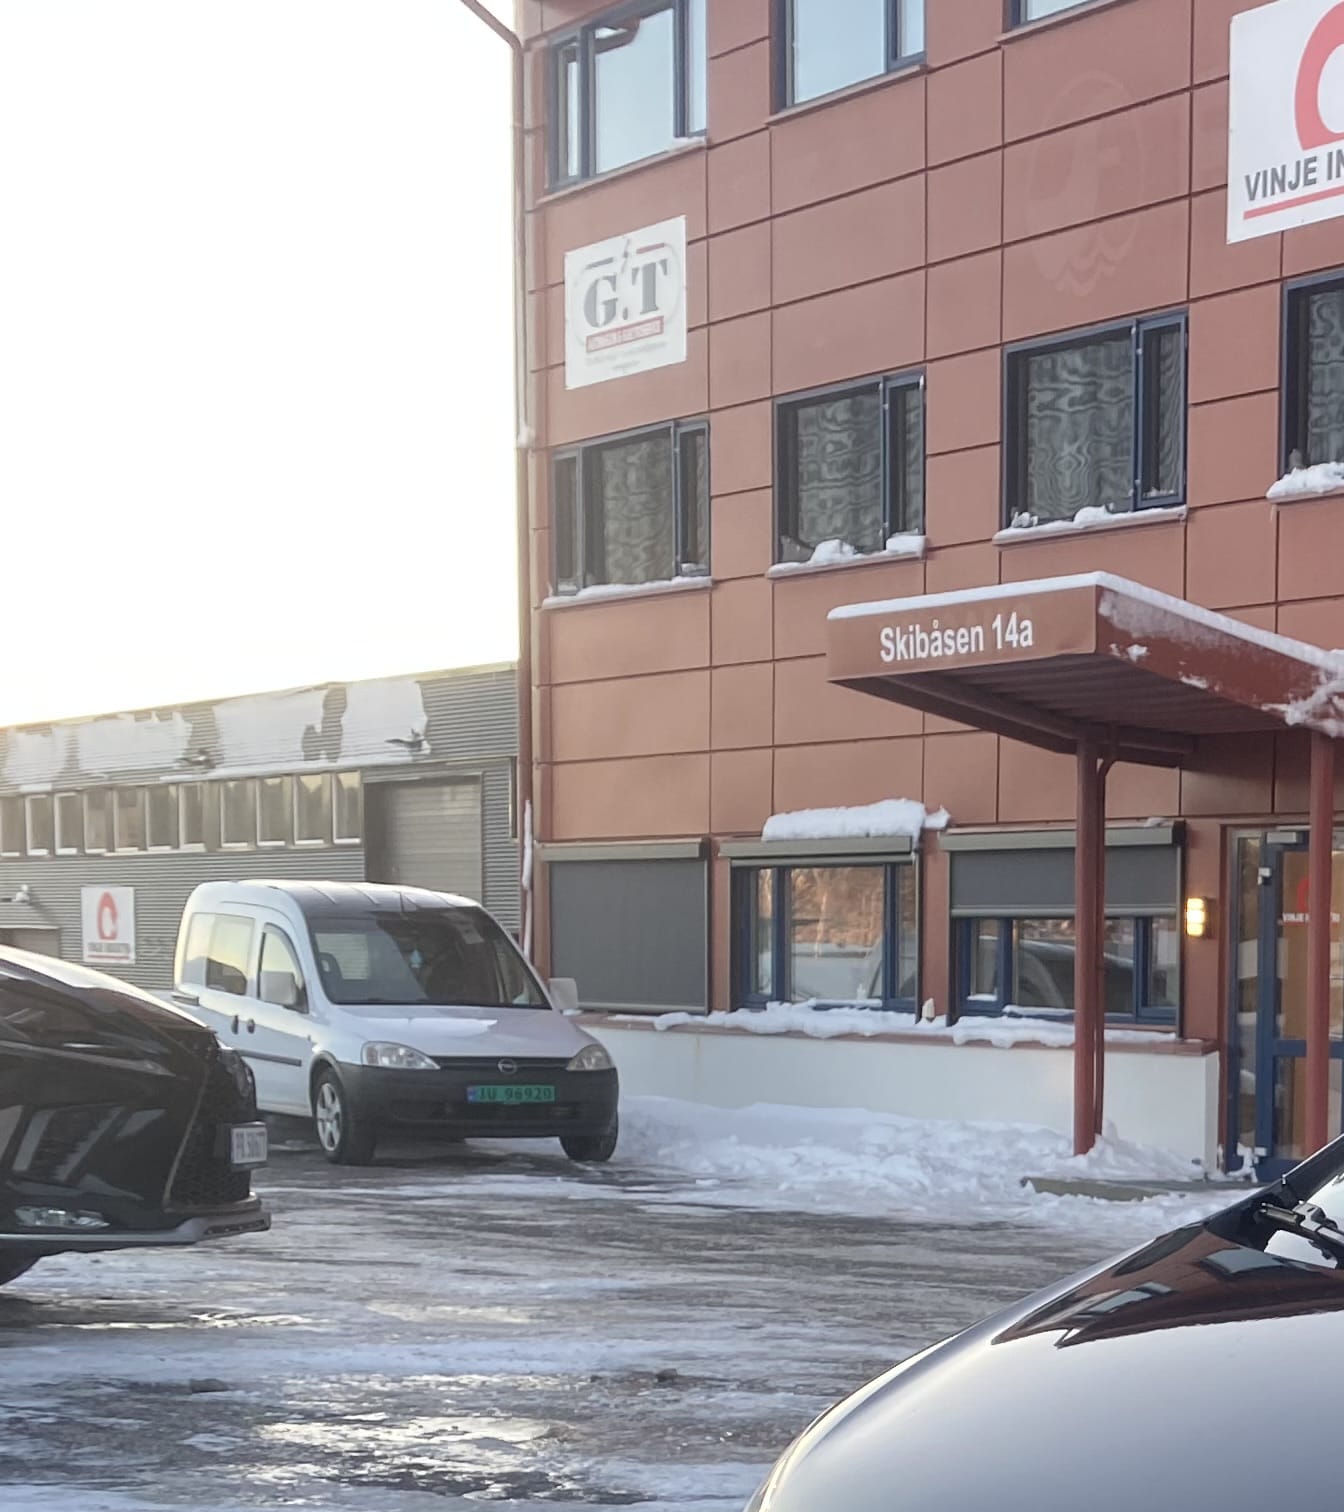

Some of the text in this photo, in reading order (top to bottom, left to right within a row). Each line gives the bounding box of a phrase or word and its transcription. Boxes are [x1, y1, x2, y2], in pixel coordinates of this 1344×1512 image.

[1244, 155, 1318, 202] VINJE
[879, 611, 1034, 663] Skibåsen 14a
